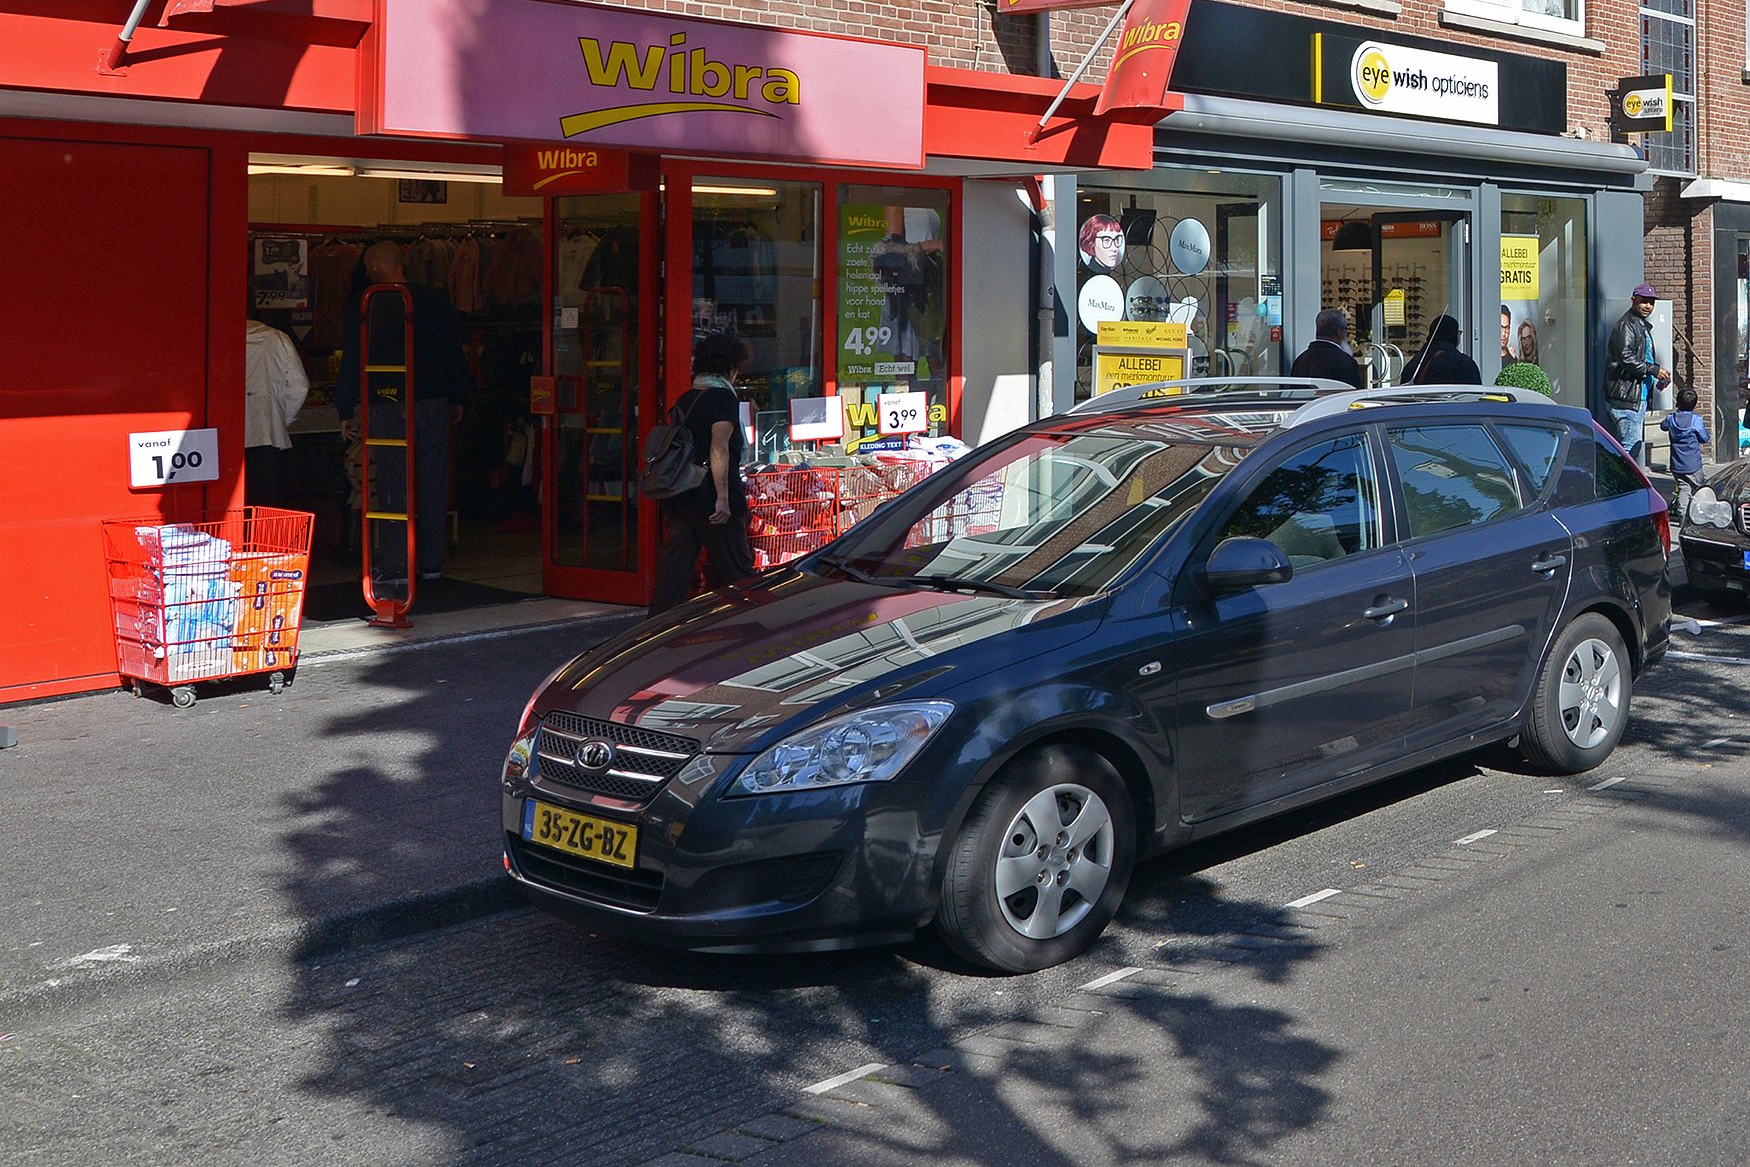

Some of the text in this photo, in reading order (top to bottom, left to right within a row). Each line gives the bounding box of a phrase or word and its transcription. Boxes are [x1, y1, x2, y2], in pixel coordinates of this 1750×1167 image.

[1122, 17, 1181, 50] Wibra
[577, 31, 800, 105] Wibra
[1362, 66, 1489, 99] eye wish opticiens
[1626, 97, 1663, 110] eye wish
[537, 148, 598, 170] Wibra
[848, 214, 889, 228] Wibra
[846, 243, 863, 254] Echt
[845, 269, 882, 280] helemaal
[845, 281, 905, 295] hippe spulletjes
[845, 296, 886, 306] voor hond
[844, 326, 892, 355] 4.99
[1118, 358, 1162, 371] ALLEBEI
[889, 409, 917, 429] 3,99
[138, 438, 171, 448] vanaf
[860, 442, 886, 450] KLEDING
[152, 451, 202, 479] 1,00
[583, 743, 605, 762] KIA
[540, 810, 629, 860] 35-ZG-BZ
